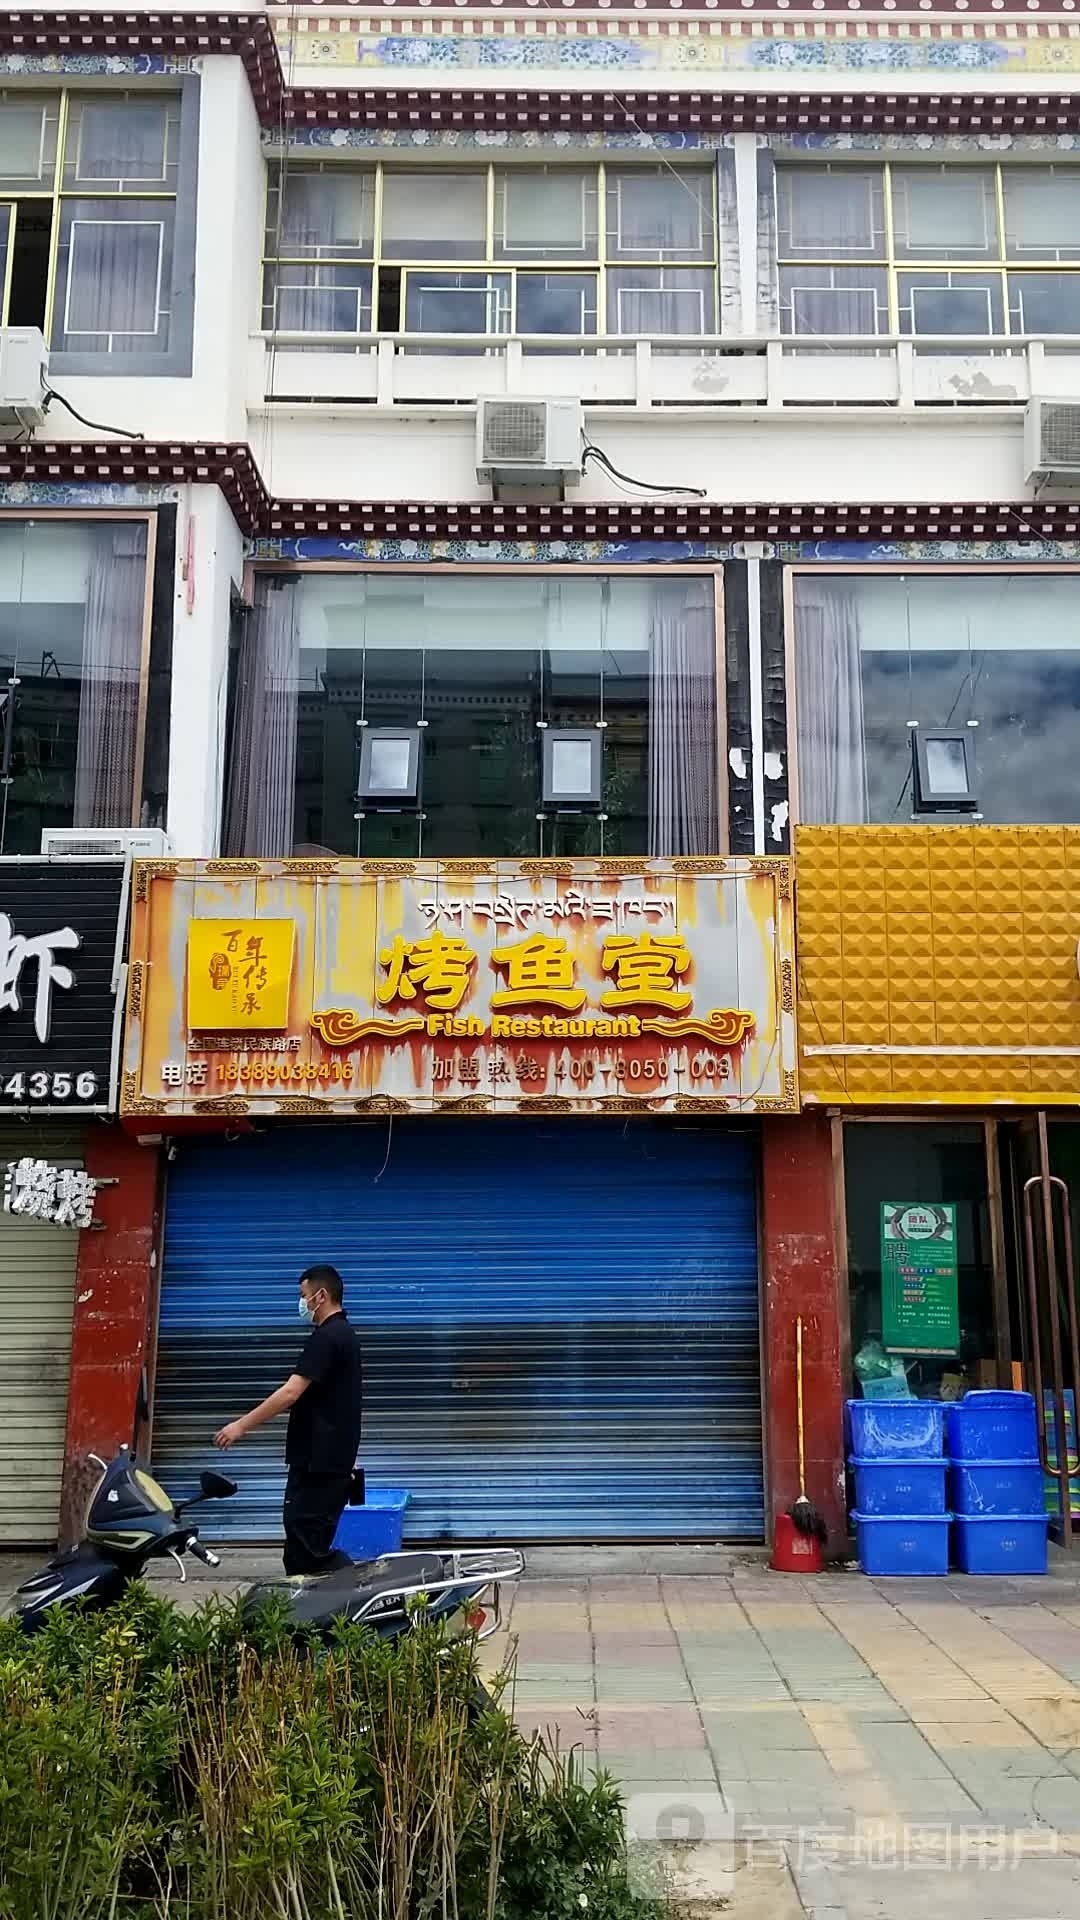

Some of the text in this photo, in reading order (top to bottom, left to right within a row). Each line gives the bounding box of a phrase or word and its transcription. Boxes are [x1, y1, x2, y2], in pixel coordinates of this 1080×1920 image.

[221, 929, 268, 1016] 百年传承
[375, 930, 694, 1011] 烤鱼堂
[426, 1013, 642, 1038] Fish Restaurant
[188, 1036, 303, 1052] 全国连锁民族路店
[0, 1071, 97, 1099] 4356
[160, 1060, 354, 1086] 电话 18389038416
[885, 1241, 911, 1265] 聘
